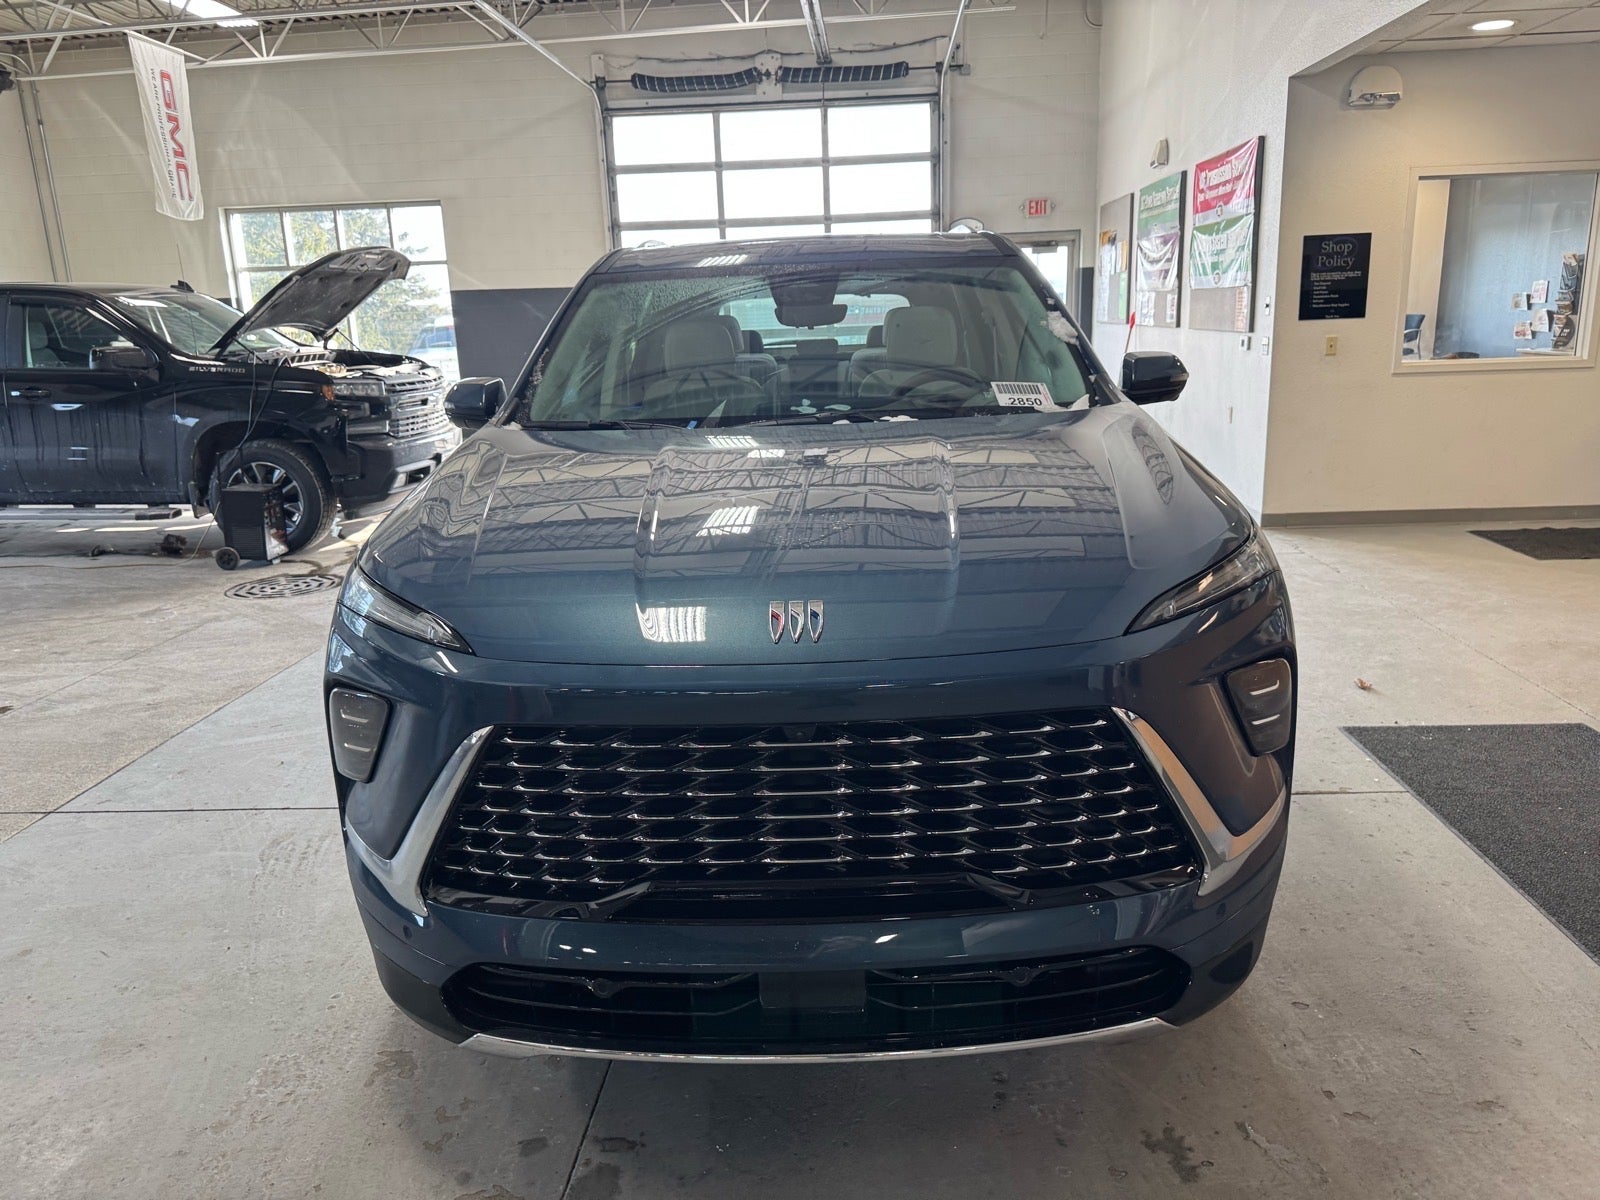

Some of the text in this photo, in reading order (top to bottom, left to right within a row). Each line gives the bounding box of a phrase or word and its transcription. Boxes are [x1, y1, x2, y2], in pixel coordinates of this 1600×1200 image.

[160, 69, 194, 202] GMC
[1028, 199, 1048, 216] EXIT
[1321, 240, 1353, 256] Shop
[1318, 255, 1356, 270] Policy
[189, 366, 246, 374] SILVERADO
[1008, 397, 1043, 406] 2850
